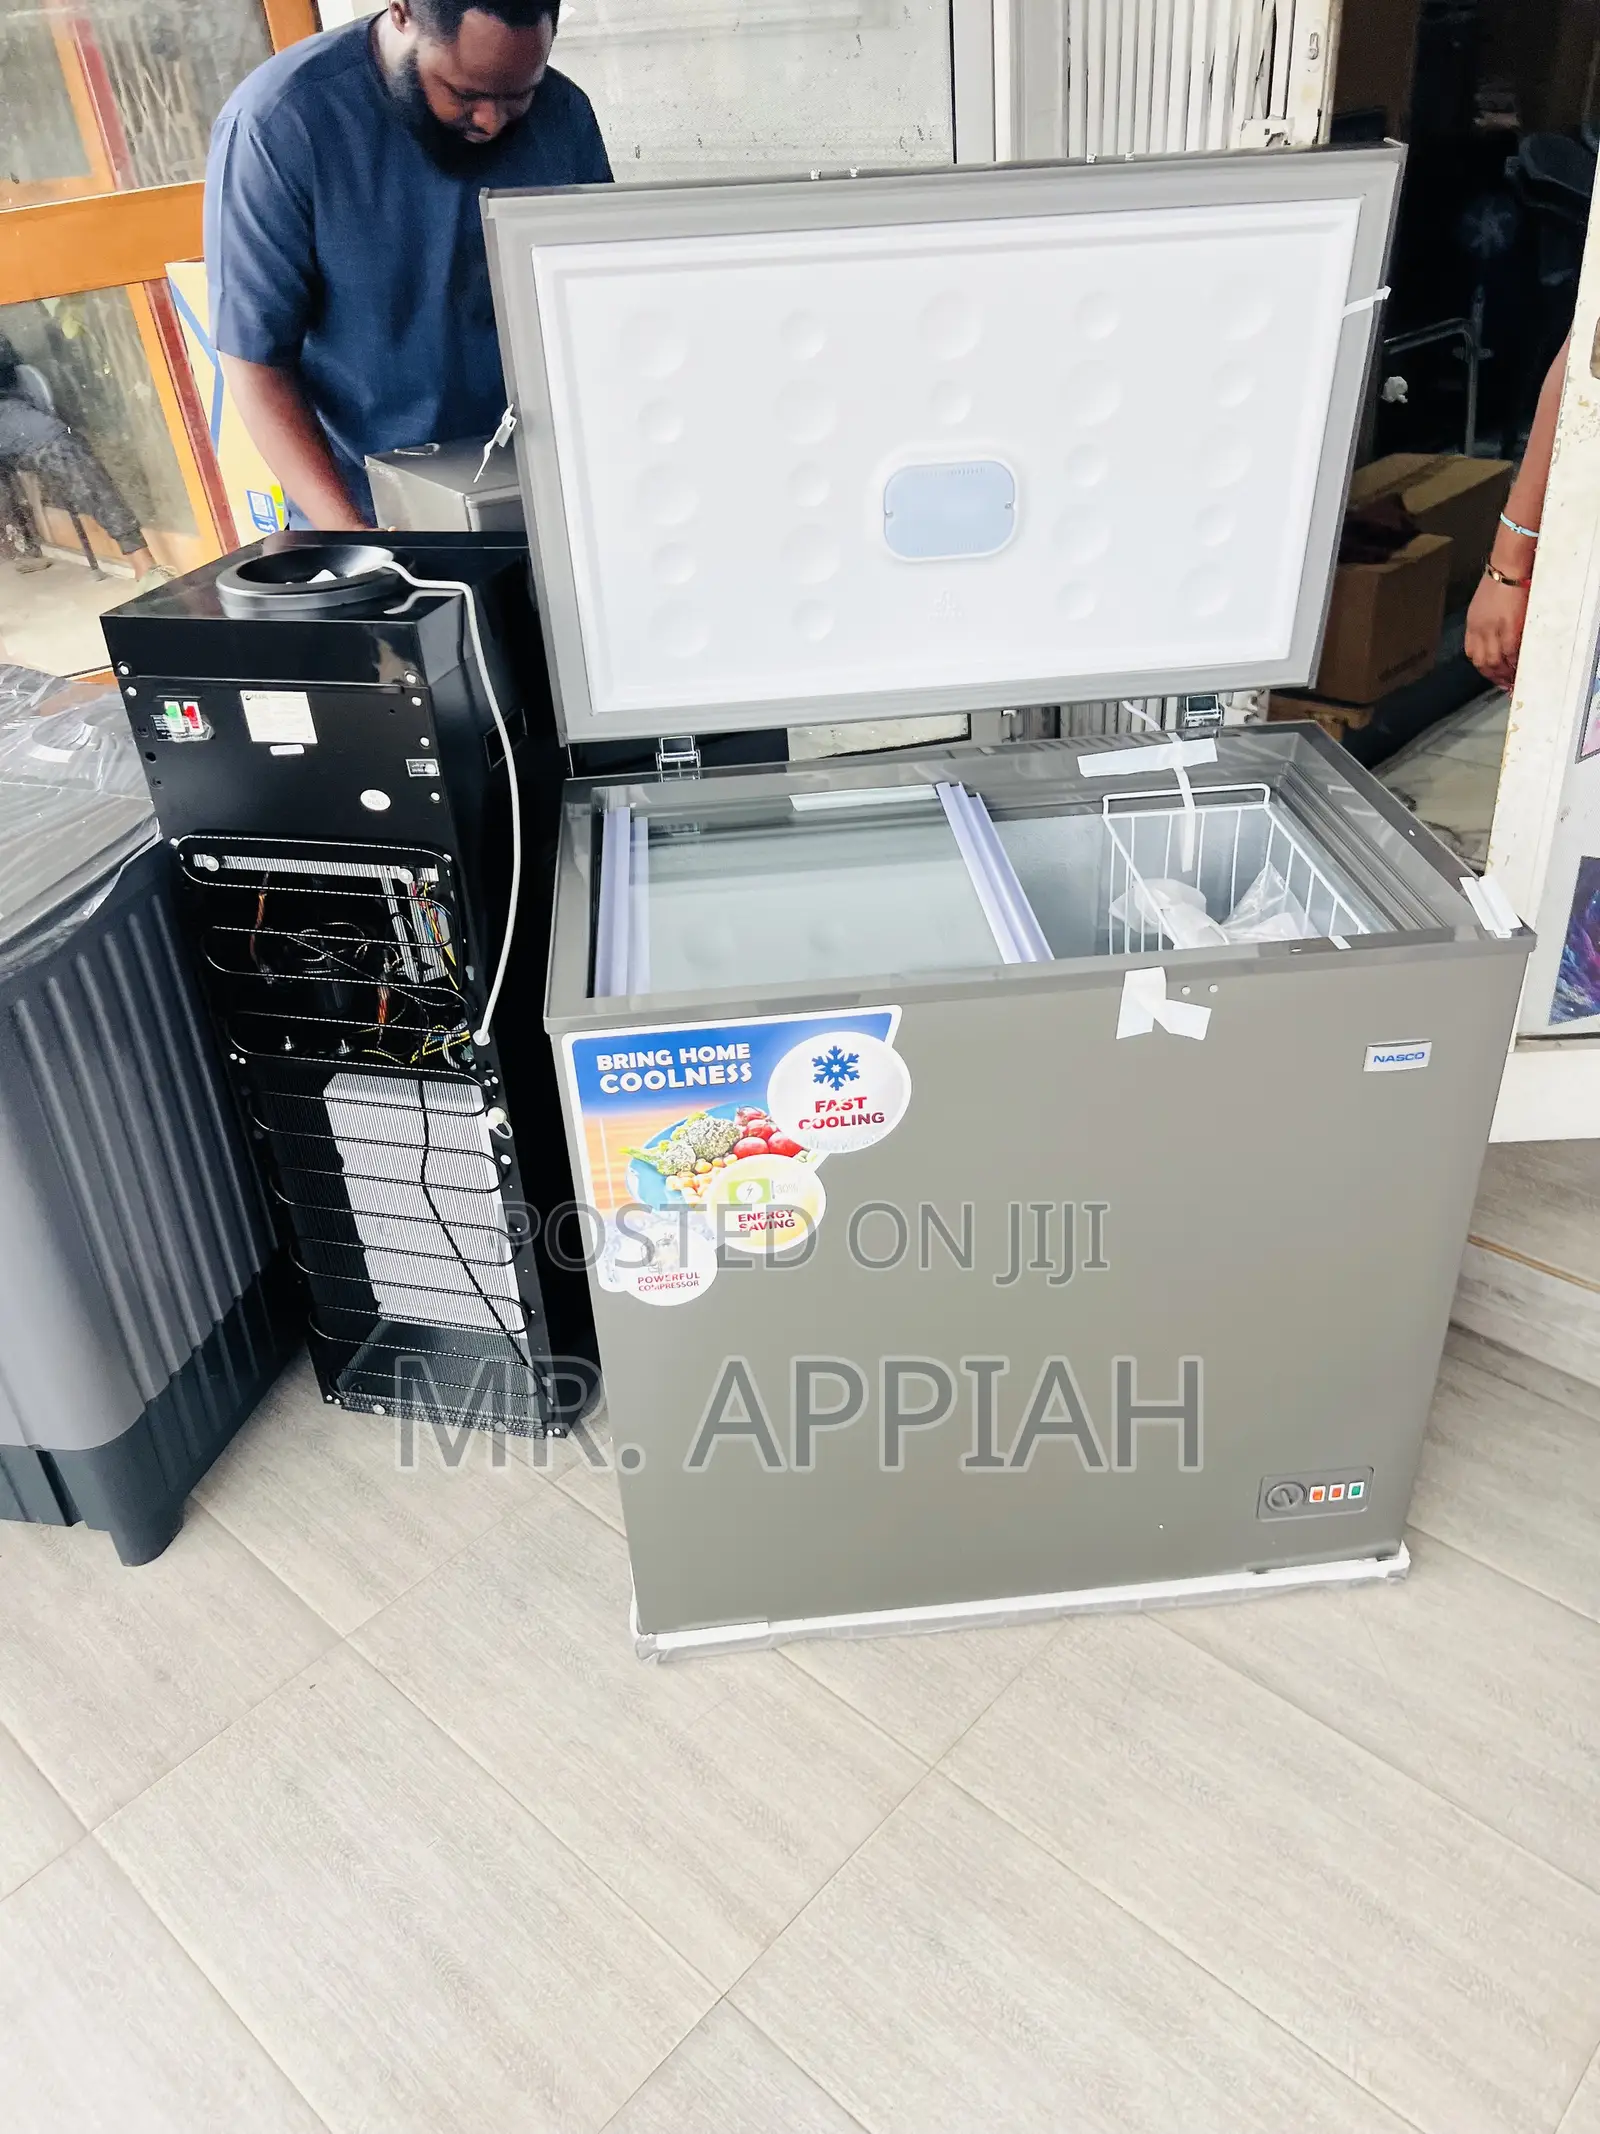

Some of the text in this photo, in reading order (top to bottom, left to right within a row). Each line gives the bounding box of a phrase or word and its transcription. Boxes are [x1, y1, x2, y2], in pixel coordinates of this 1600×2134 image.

[596, 1043, 750, 1071] BRING HOME
[1373, 1051, 1425, 1063] NASCO
[600, 1062, 752, 1094] COOLNESS
[815, 1096, 867, 1113] FAST
[798, 1112, 885, 1130] COOLING
[738, 1209, 794, 1223] ENERGY
[738, 1219, 796, 1232] SAVING
